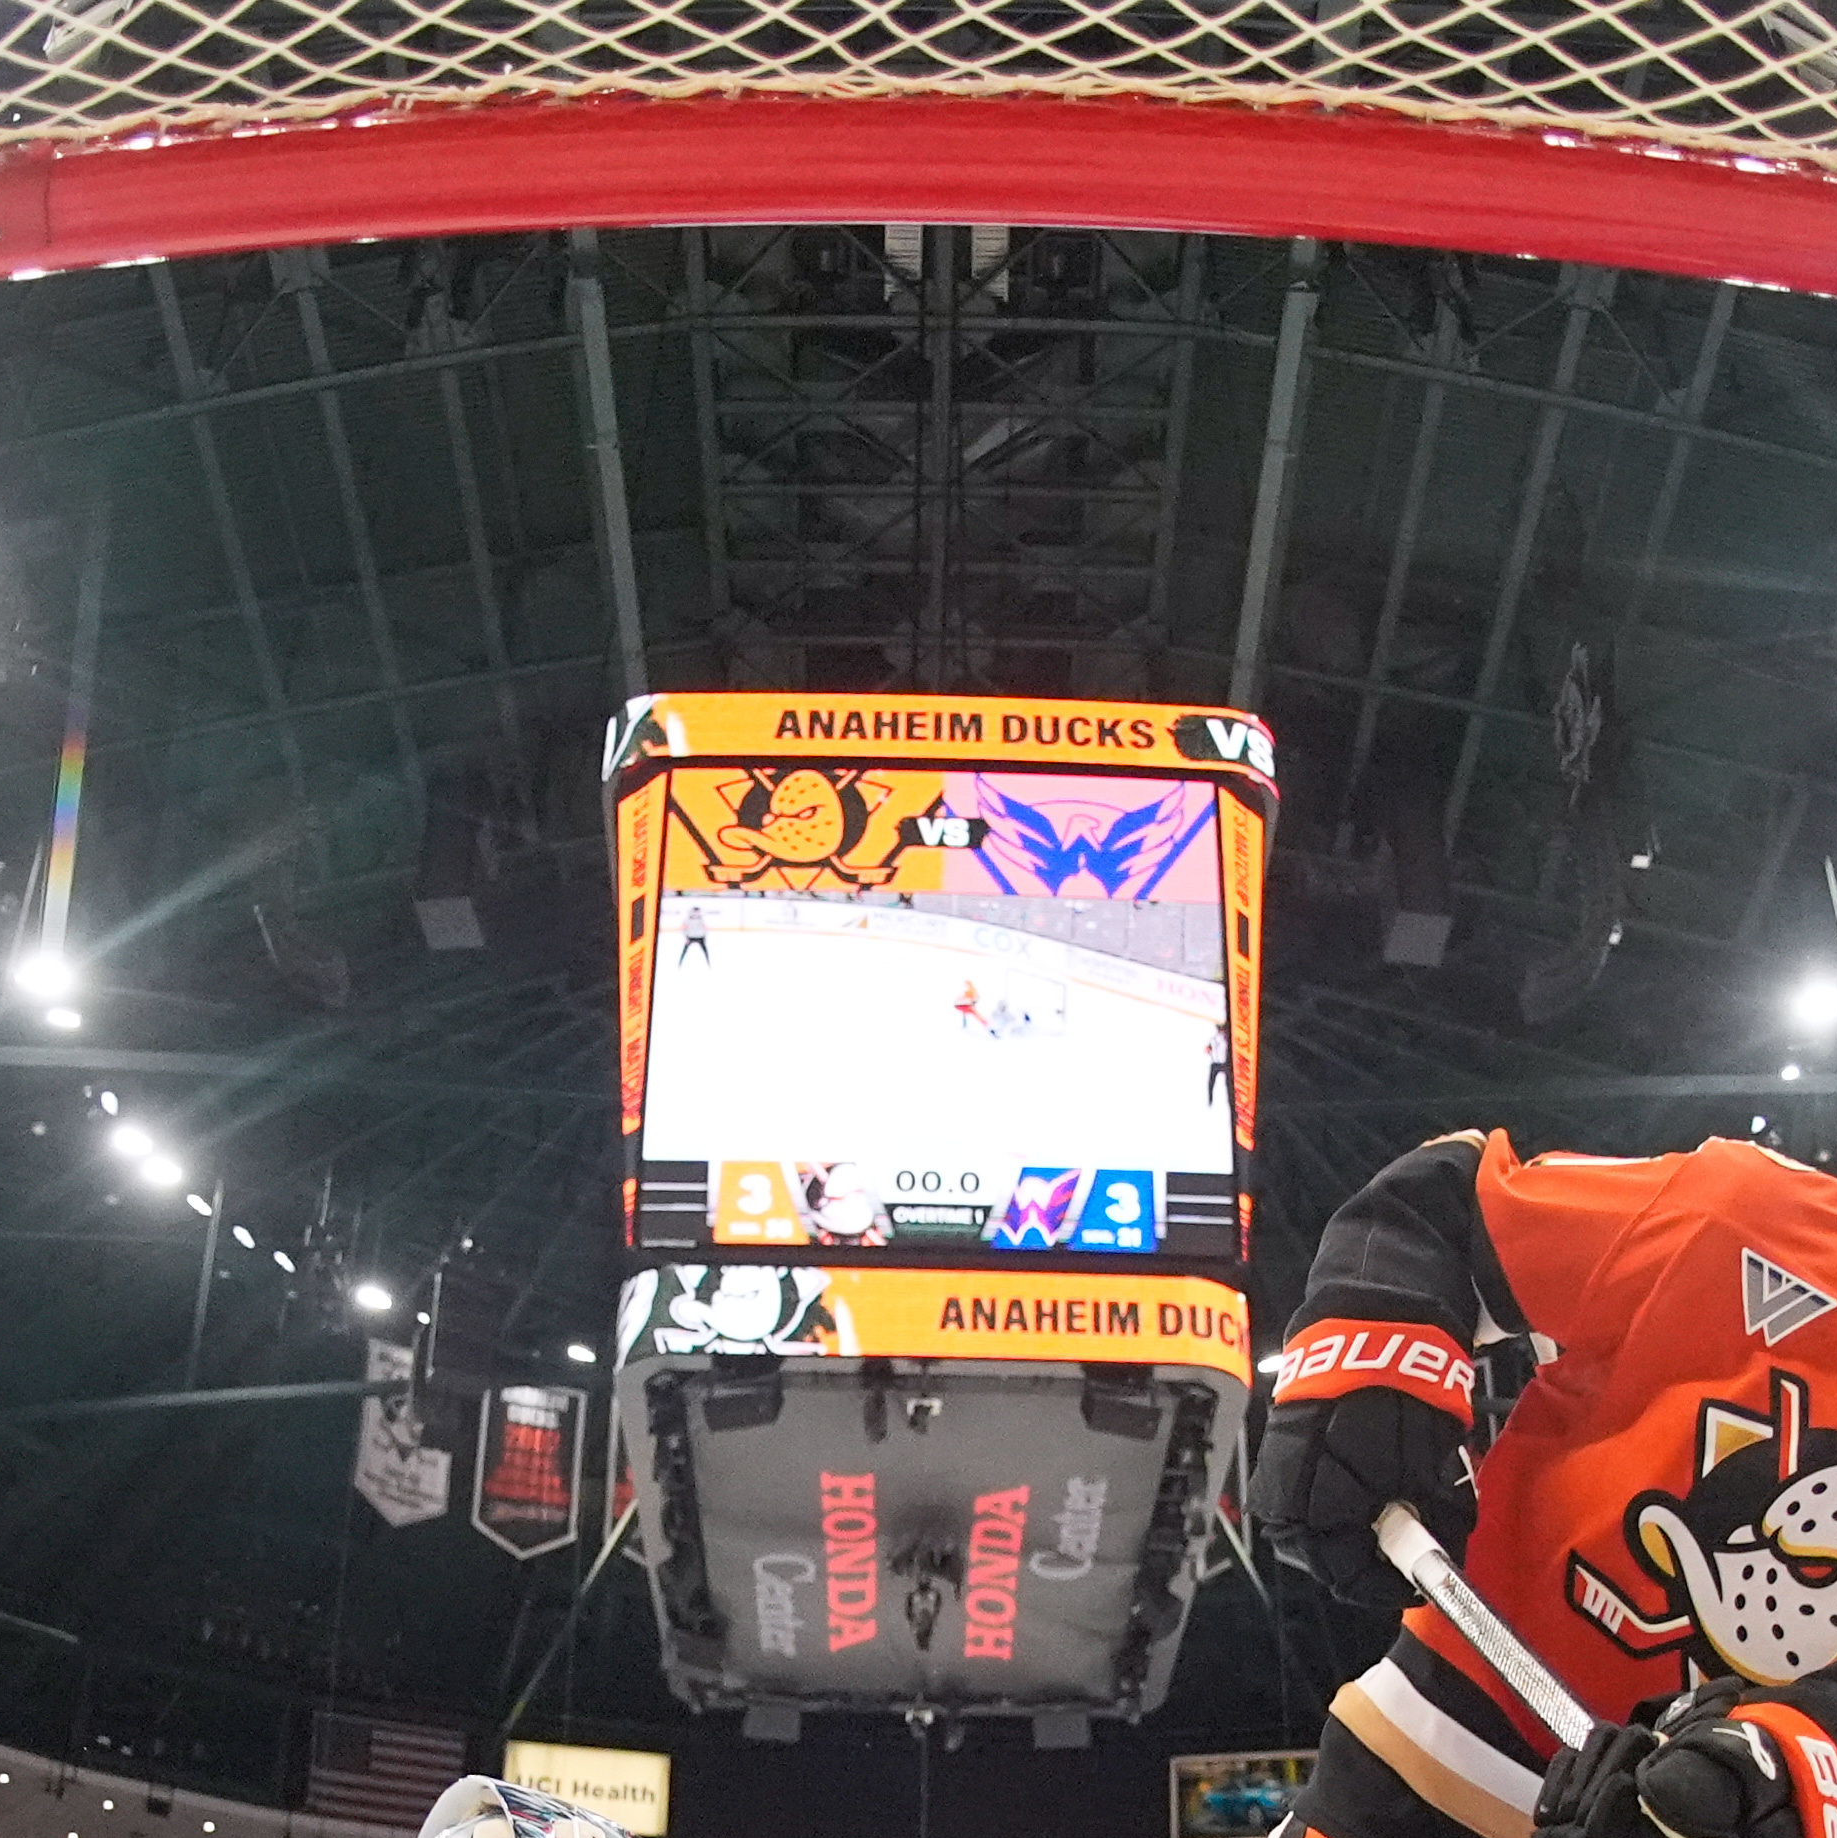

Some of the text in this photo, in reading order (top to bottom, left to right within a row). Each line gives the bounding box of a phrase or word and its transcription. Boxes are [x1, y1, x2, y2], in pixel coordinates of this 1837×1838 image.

[775, 710, 1276, 777] ANAHEIM DUCKS VS
[917, 816, 971, 849] VS
[736, 1173, 773, 1215] 3
[895, 1169, 981, 1194] 00.0
[892, 1206, 973, 1226] OVERTIME
[1104, 1182, 1142, 1225] 3
[940, 1296, 1140, 1337] ANAHEIM
[820, 1473, 878, 1651] HONDA
[964, 1485, 1031, 1661] HONDA
[572, 1779, 658, 1803] Health
